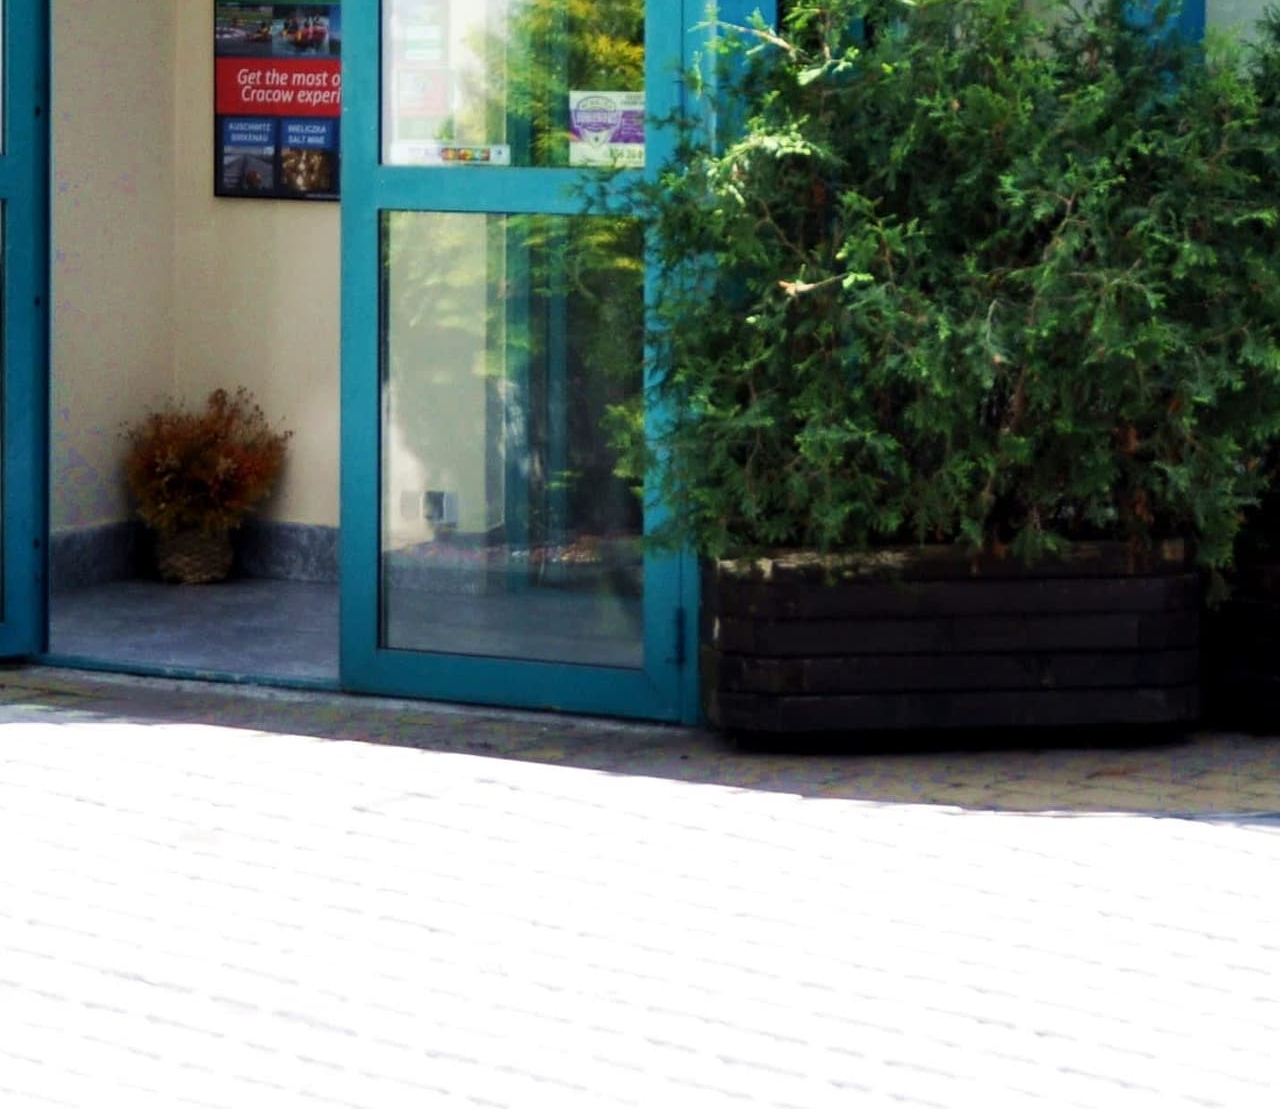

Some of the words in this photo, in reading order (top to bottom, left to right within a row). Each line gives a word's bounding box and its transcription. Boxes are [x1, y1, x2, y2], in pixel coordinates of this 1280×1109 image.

[237, 68, 262, 85] Get
[265, 68, 289, 85] the
[292, 71, 328, 87] most
[241, 85, 294, 103] Cracow
